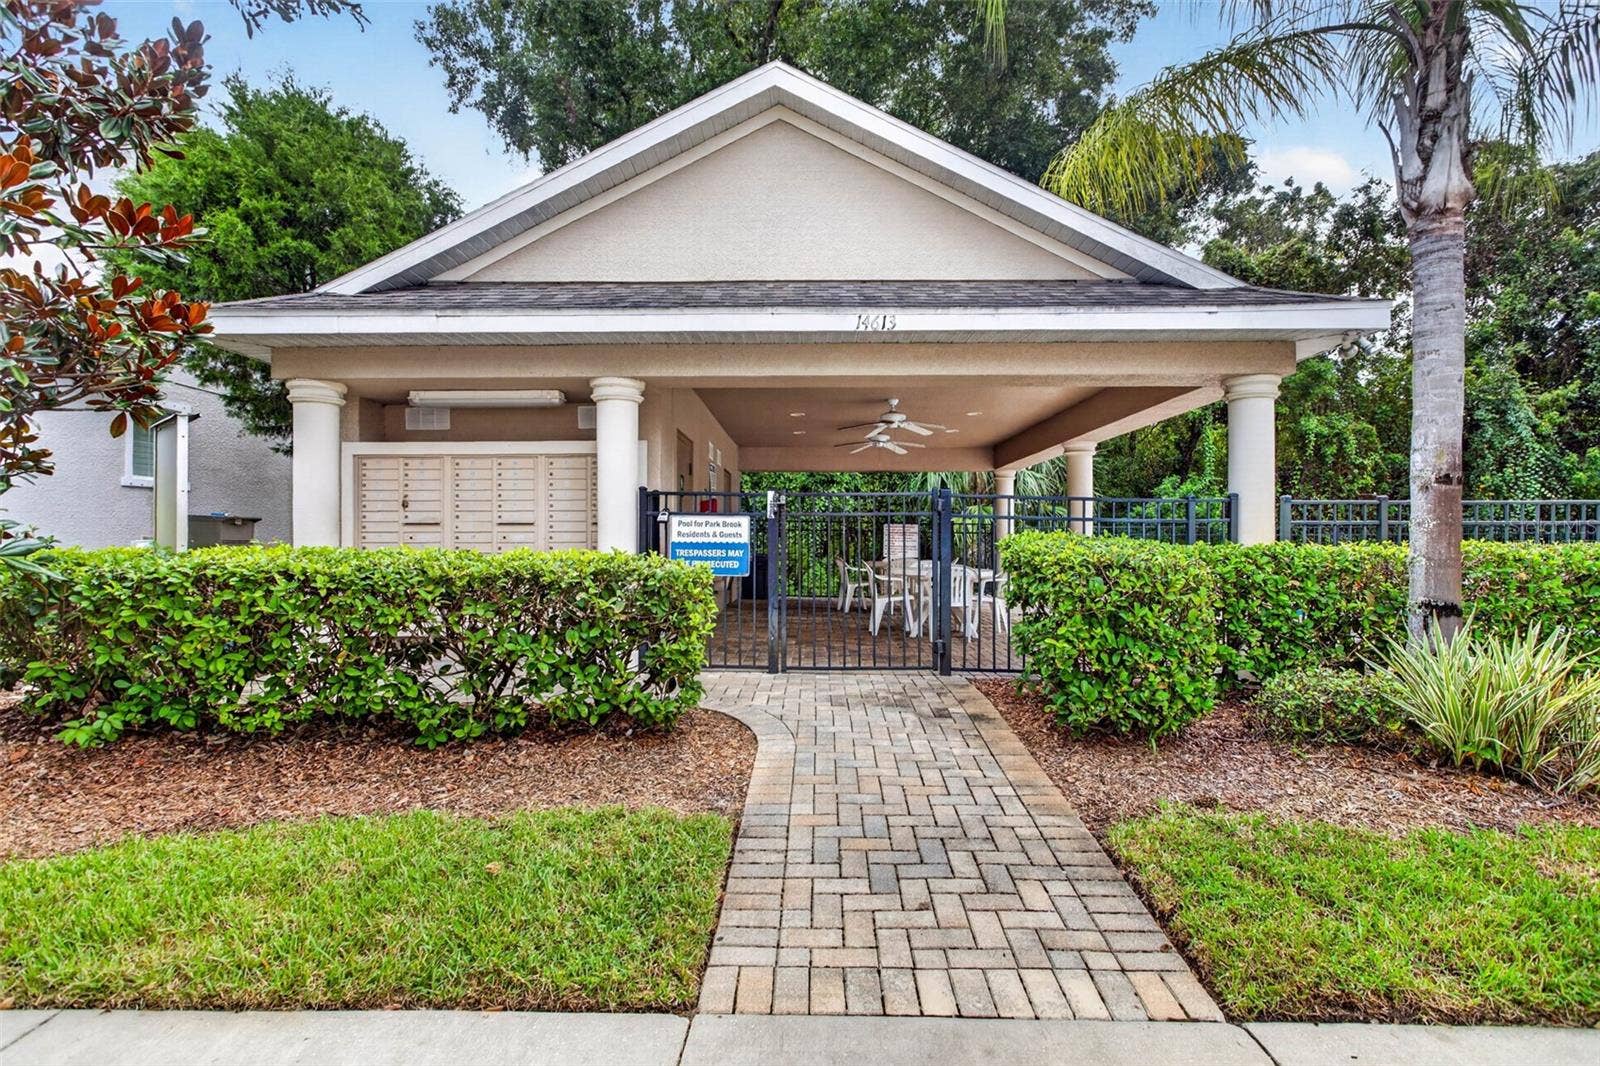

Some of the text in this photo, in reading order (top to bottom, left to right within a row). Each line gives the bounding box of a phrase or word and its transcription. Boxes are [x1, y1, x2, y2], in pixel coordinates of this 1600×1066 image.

[856, 314, 896, 330] 14613
[677, 520, 742, 528] Pool for Park Brook
[677, 530, 743, 538] Residents & Guests
[675, 549, 744, 557] TRESPASSERS MAY
